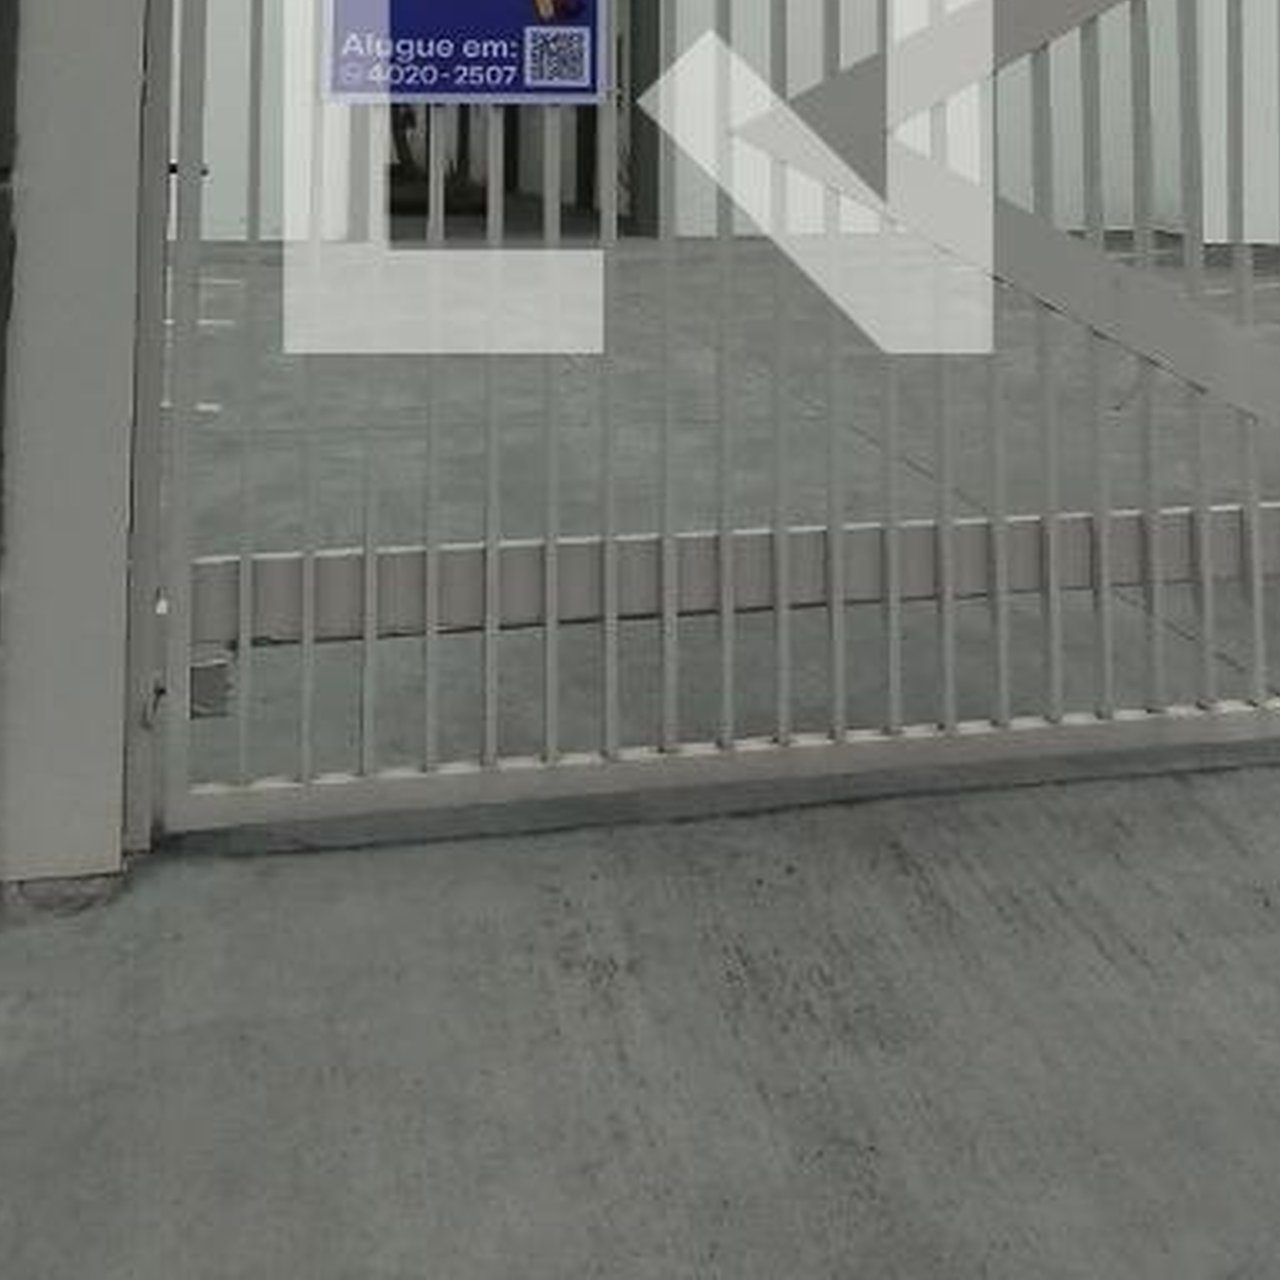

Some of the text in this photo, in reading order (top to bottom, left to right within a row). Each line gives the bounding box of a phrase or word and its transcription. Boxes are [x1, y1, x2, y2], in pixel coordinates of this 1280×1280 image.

[341, 32, 519, 62] Alugue em:
[368, 65, 518, 86] 4020-2507
